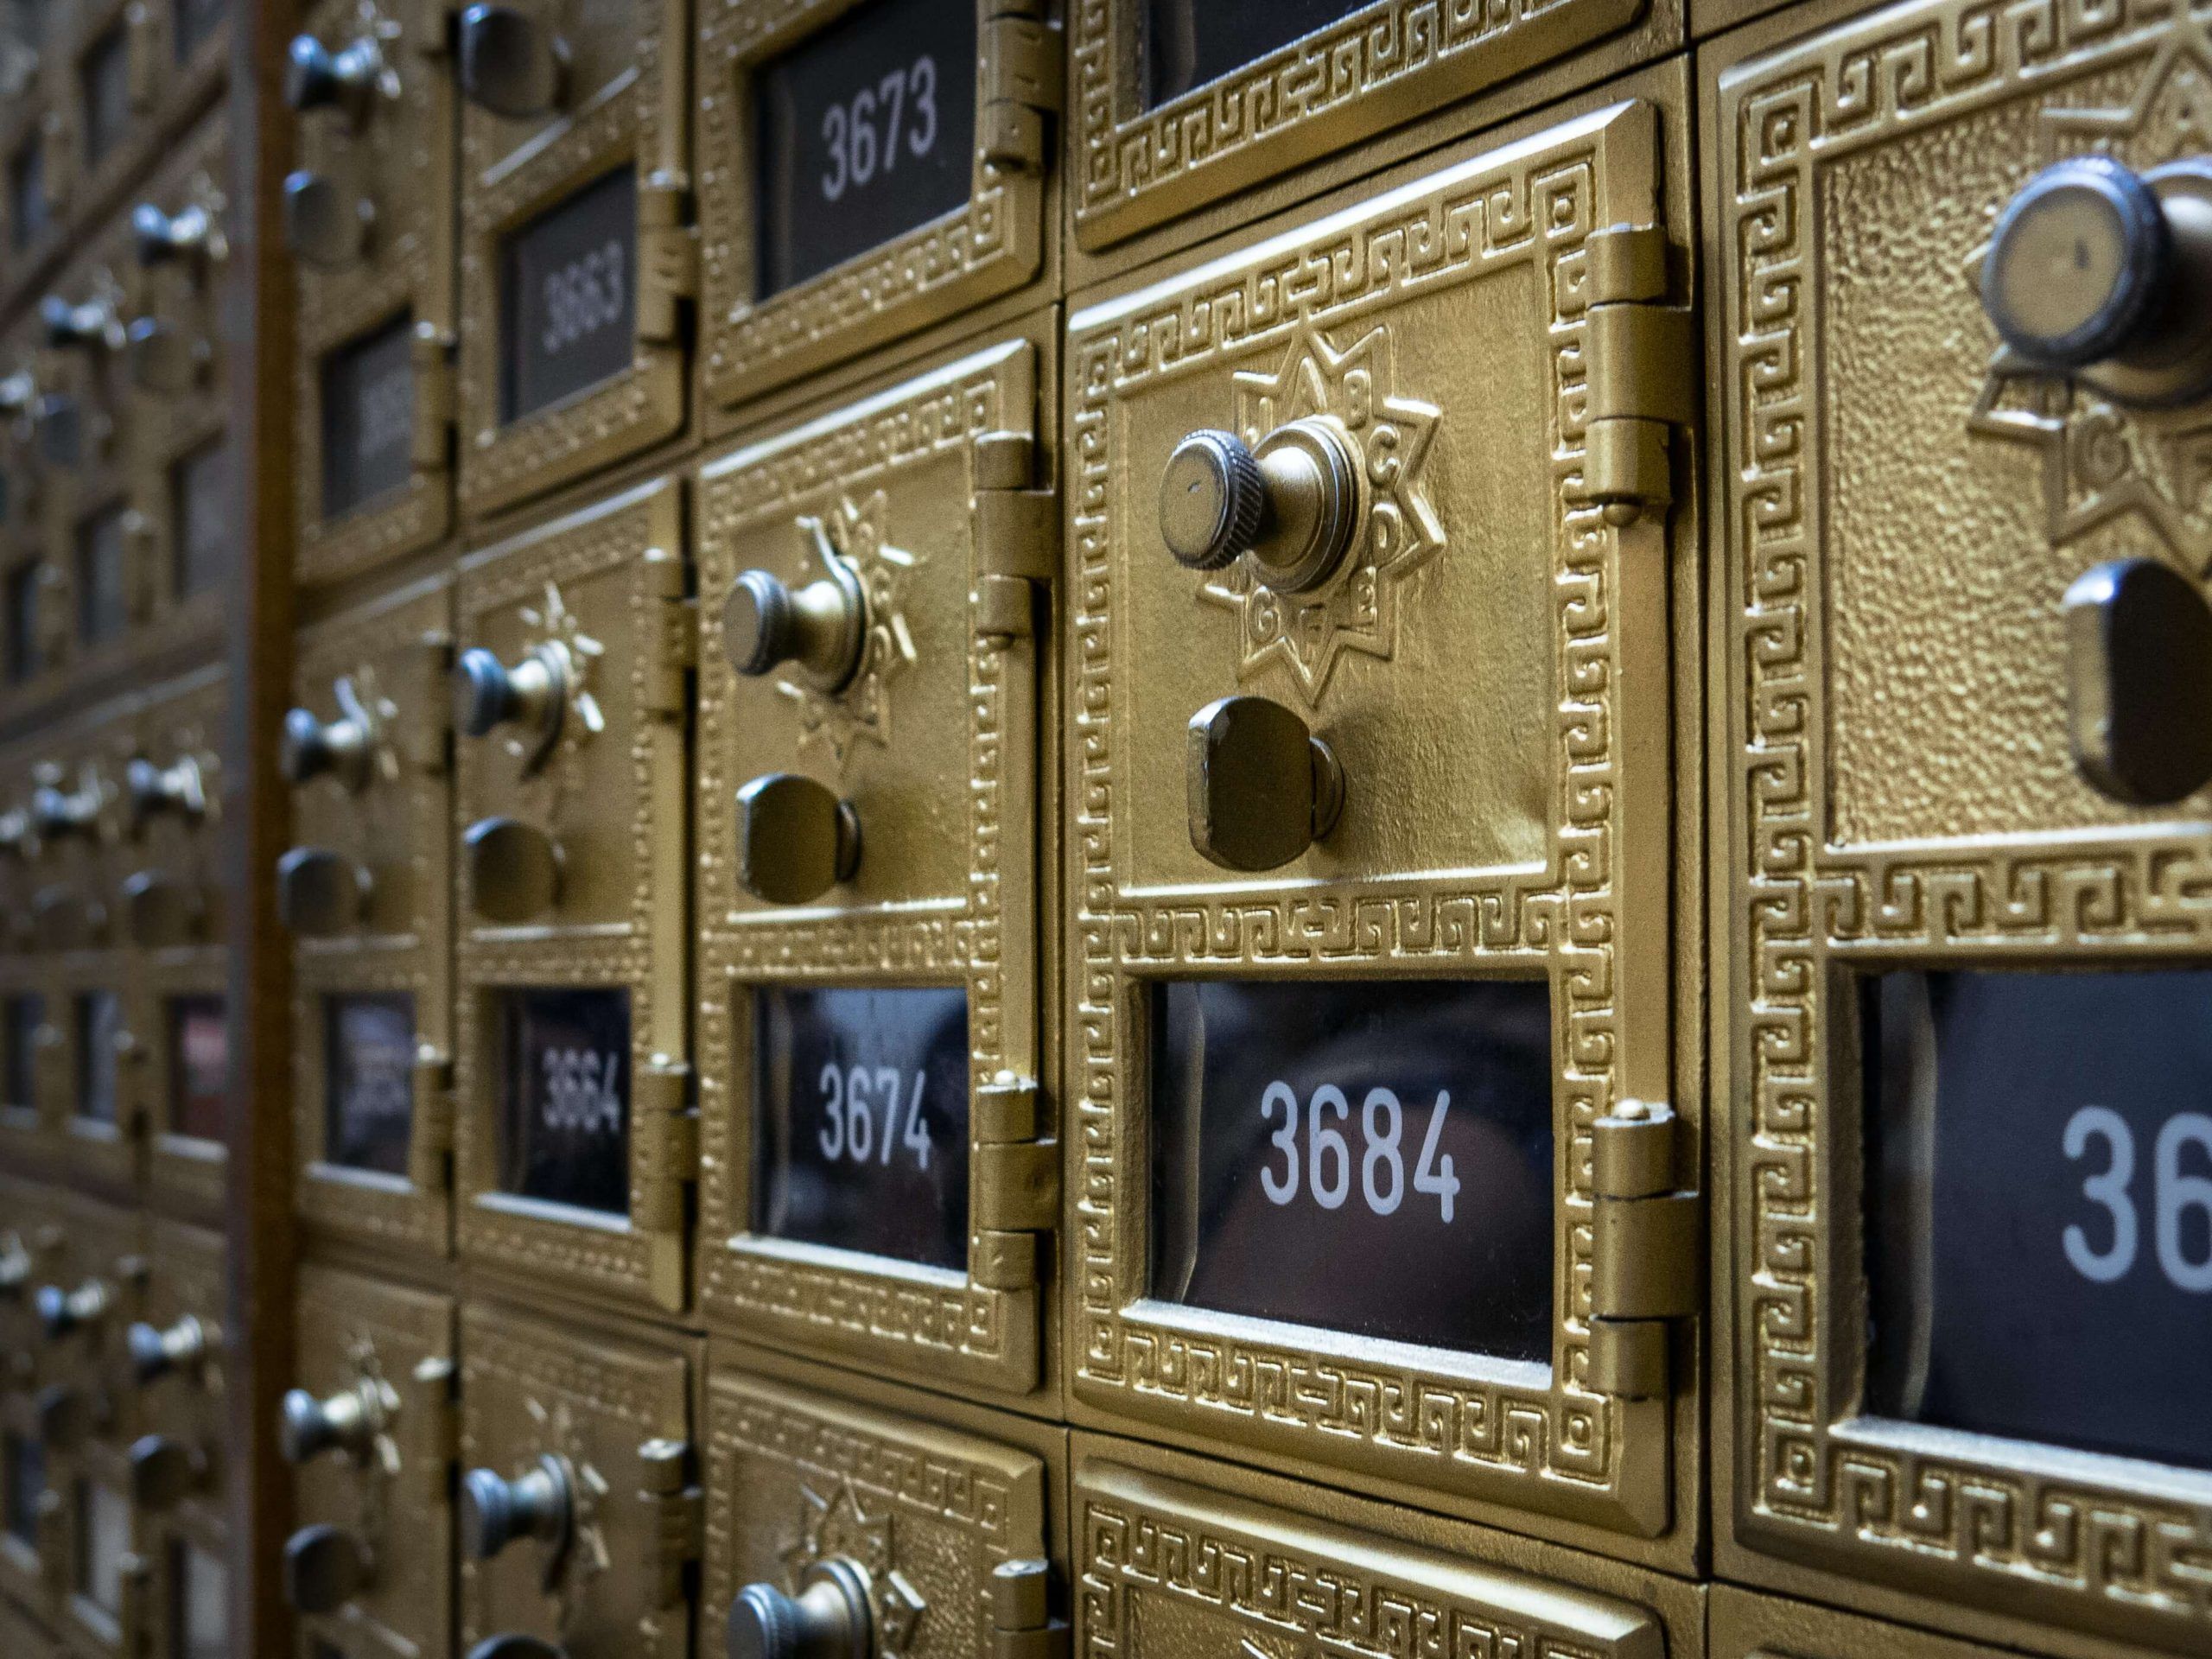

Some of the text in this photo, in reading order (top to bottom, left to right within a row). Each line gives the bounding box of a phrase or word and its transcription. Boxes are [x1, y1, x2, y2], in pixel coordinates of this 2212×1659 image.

[820, 57, 937, 200] 3673
[1367, 424, 1402, 486] C
[1372, 502, 1402, 567] D
[820, 1064, 930, 1170] 3674
[1261, 1080, 1460, 1224] 3684
